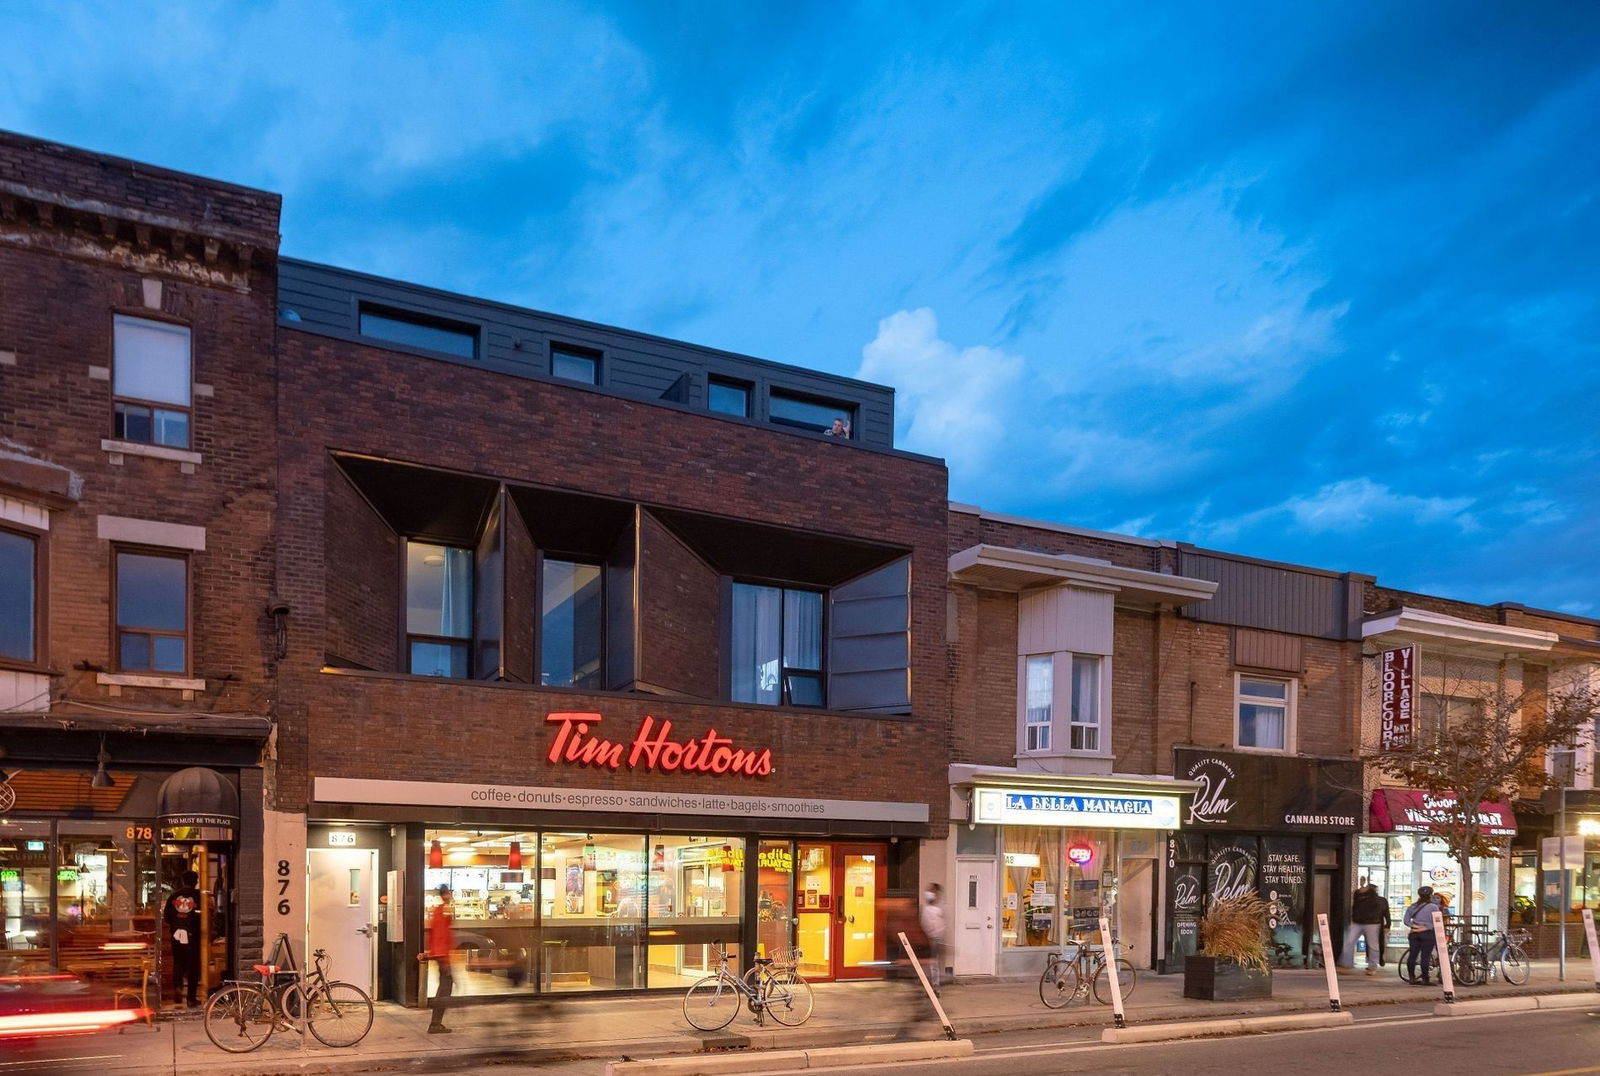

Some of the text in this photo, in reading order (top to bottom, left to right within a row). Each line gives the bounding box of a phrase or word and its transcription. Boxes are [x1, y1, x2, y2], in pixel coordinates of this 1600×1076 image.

[1400, 648, 1411, 719] VILLAGE
[1382, 652, 1395, 750] BLOORCOURT
[545, 712, 772, 776] Tim Hortons
[1188, 758, 1235, 779] QUALITY CANNABIS
[471, 789, 825, 813] coffee donuts espresso sandwiches latte bagels smoothies
[1006, 796, 1152, 814] LA BELLA MANAGUA
[1188, 772, 1238, 823] Relm
[1285, 815, 1355, 826] CANNABIS STORE
[126, 827, 152, 839] 878
[1212, 848, 1231, 864] QUALITY
[1268, 854, 1283, 862] STAY
[1262, 865, 1277, 873] STAY
[1265, 875, 1279, 884] STAY
[277, 860, 291, 915] 876
[1212, 861, 1256, 907] Relm
[1174, 883, 1200, 909] Relm
